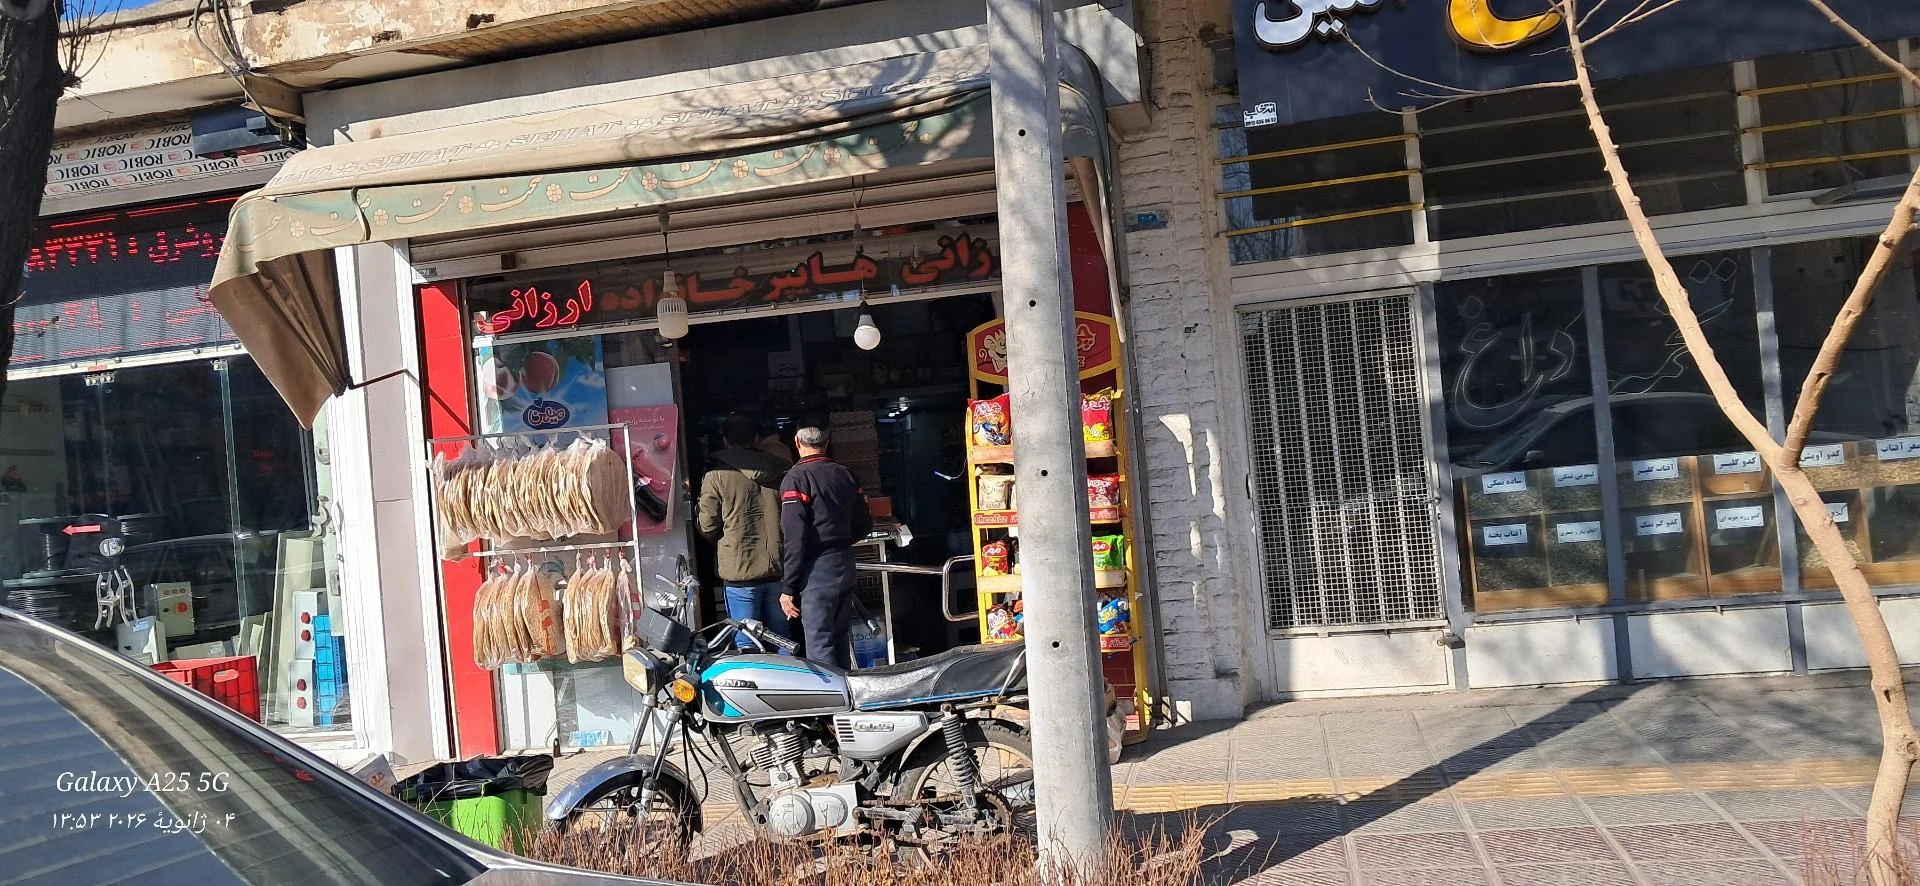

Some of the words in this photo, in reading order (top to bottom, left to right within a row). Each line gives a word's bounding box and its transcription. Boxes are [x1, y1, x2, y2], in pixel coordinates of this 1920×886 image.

[81, 142, 127, 161] ROBIC
[145, 133, 192, 151] ROBIC
[56, 163, 100, 181] ROBIC
[119, 153, 164, 171] ROBIC
[64, 178, 110, 192] ROBIC
[127, 168, 174, 183] ROBIC
[192, 158, 239, 173] ROBIC
[902, 235, 992, 285] زانی
[476, 279, 592, 334] ارزانی
[1826, 449, 1840, 460] کدو
[1742, 457, 1757, 468] کدو
[1486, 479, 1505, 489] نمکی
[1506, 476, 1522, 486] ساده
[1666, 518, 1678, 528] کدو
[1503, 528, 1522, 538] آفتاب
